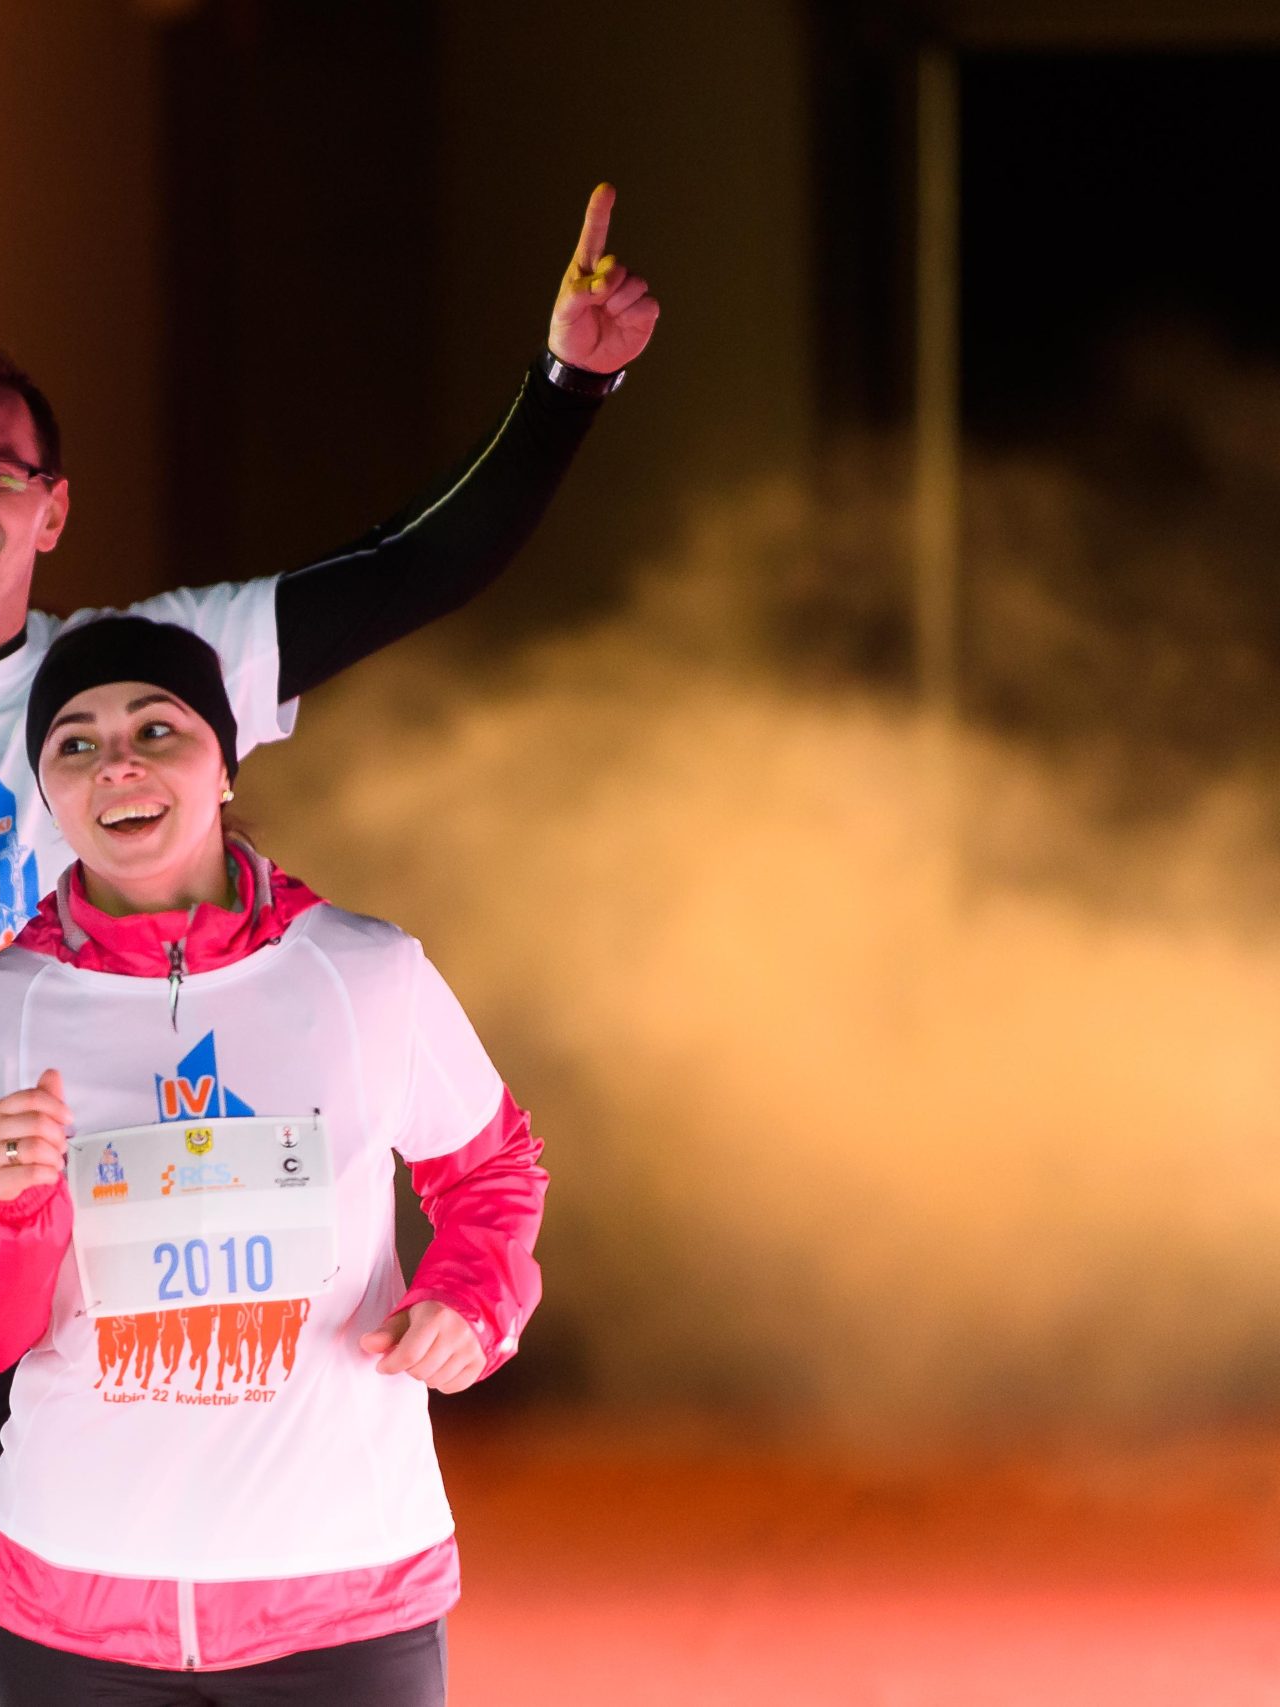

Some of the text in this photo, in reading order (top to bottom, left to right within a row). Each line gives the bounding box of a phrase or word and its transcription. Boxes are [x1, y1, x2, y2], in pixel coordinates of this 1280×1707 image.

[164, 1078, 213, 1116] IV
[153, 1235, 273, 1300] 2010
[103, 1388, 277, 1406] Lubin 22 kwietnia 2017
